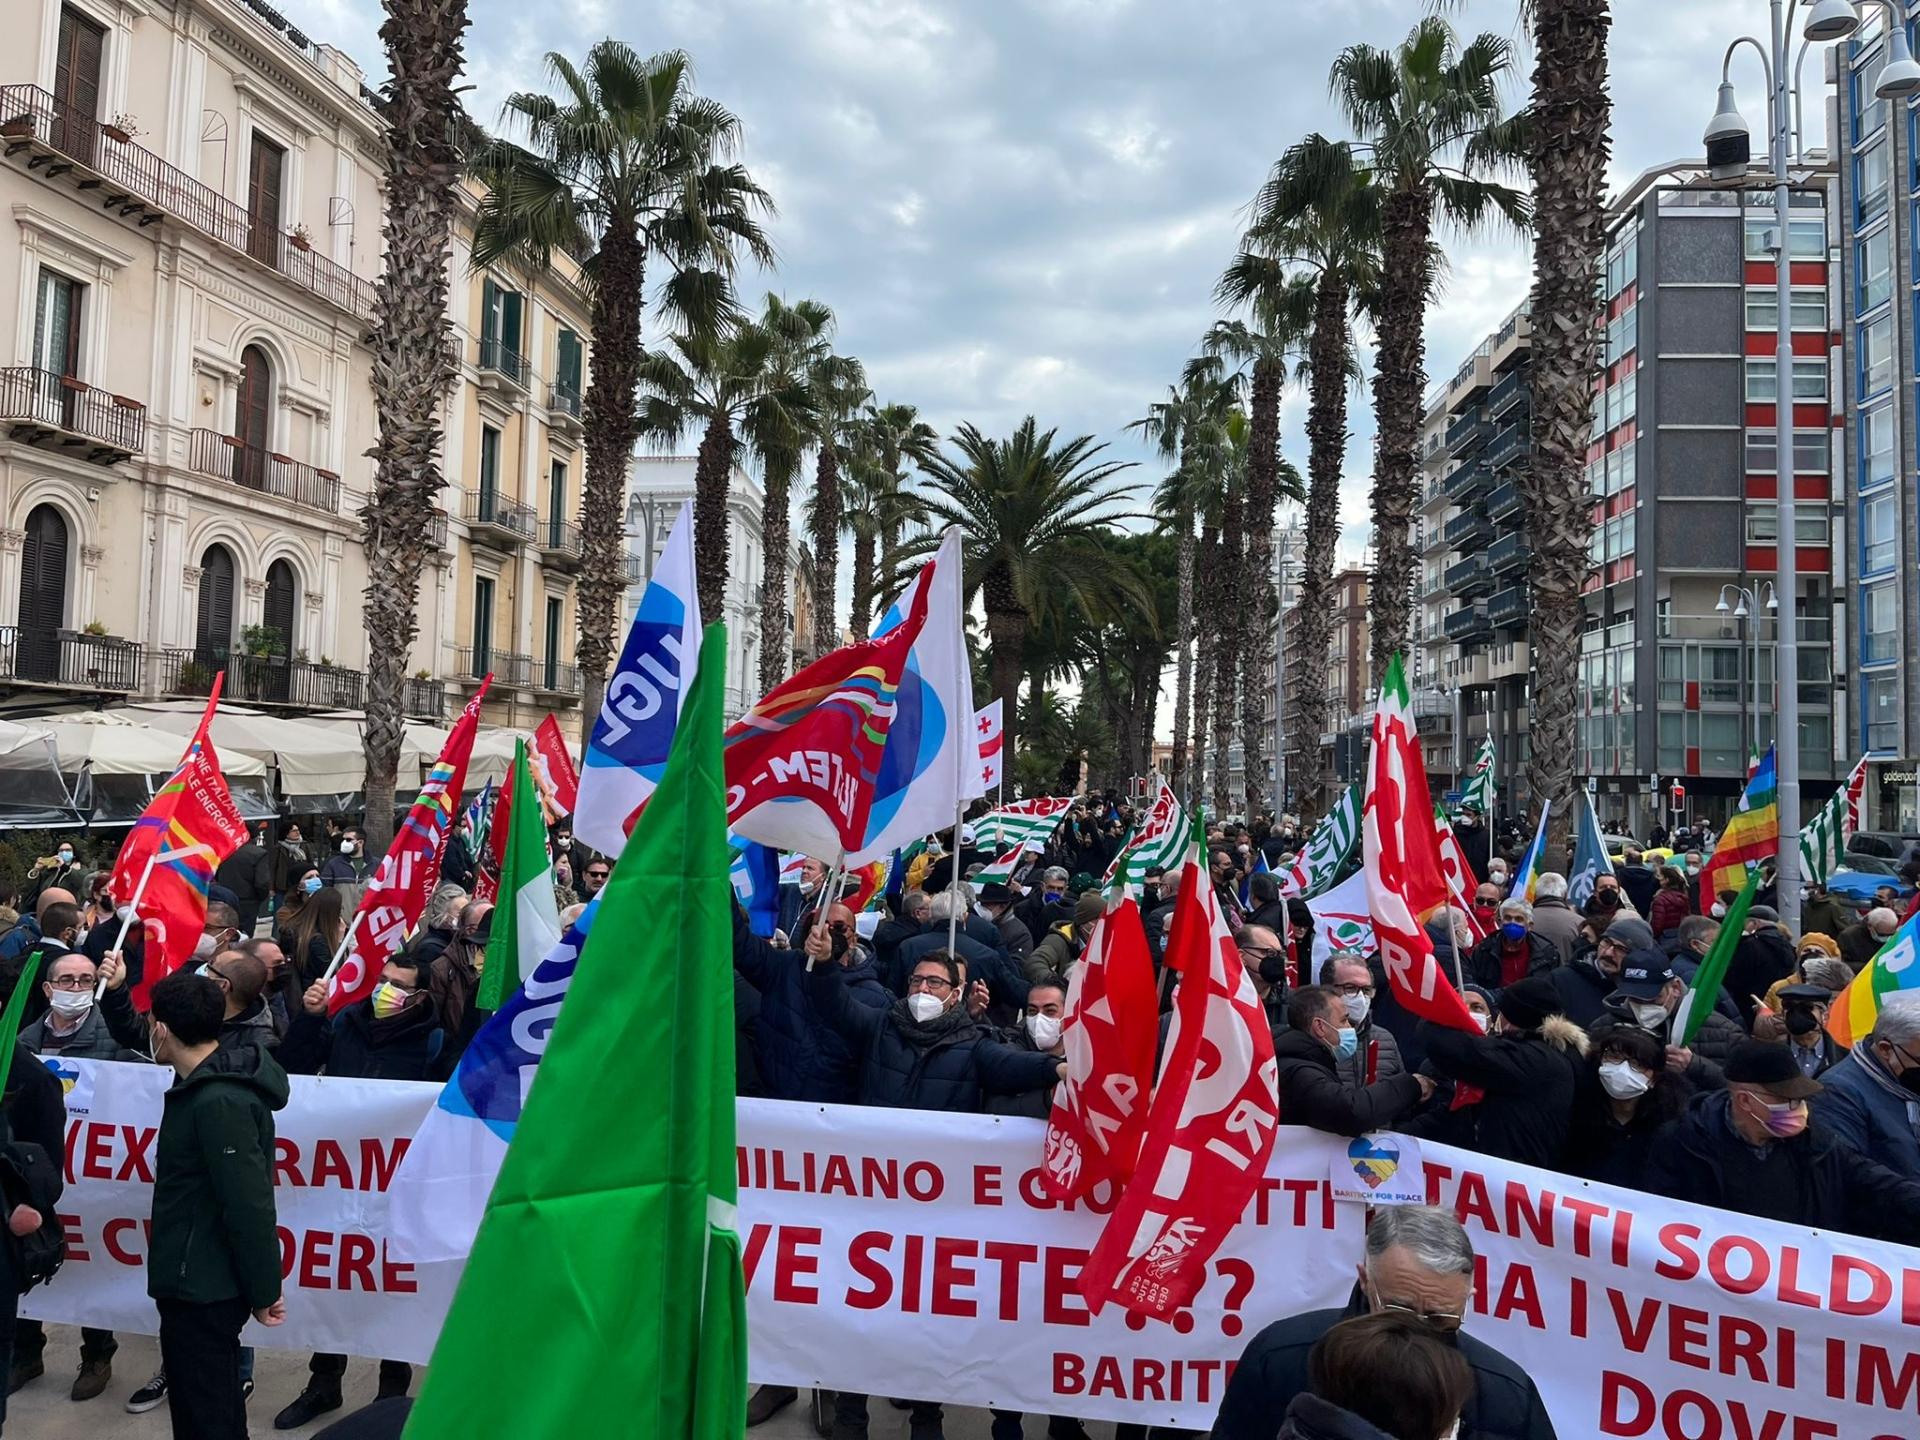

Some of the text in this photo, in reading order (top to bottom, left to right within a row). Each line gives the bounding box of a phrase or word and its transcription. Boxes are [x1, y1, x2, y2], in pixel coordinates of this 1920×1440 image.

[195, 788, 236, 838] ENERGIA
[973, 1165, 1002, 1206] E
[1334, 1189, 1422, 1202] BARITECH FOR PEACE
[844, 1230, 1092, 1327] SIETE
[1570, 1276, 1587, 1338] I
[1605, 1287, 1796, 1390] VERI
